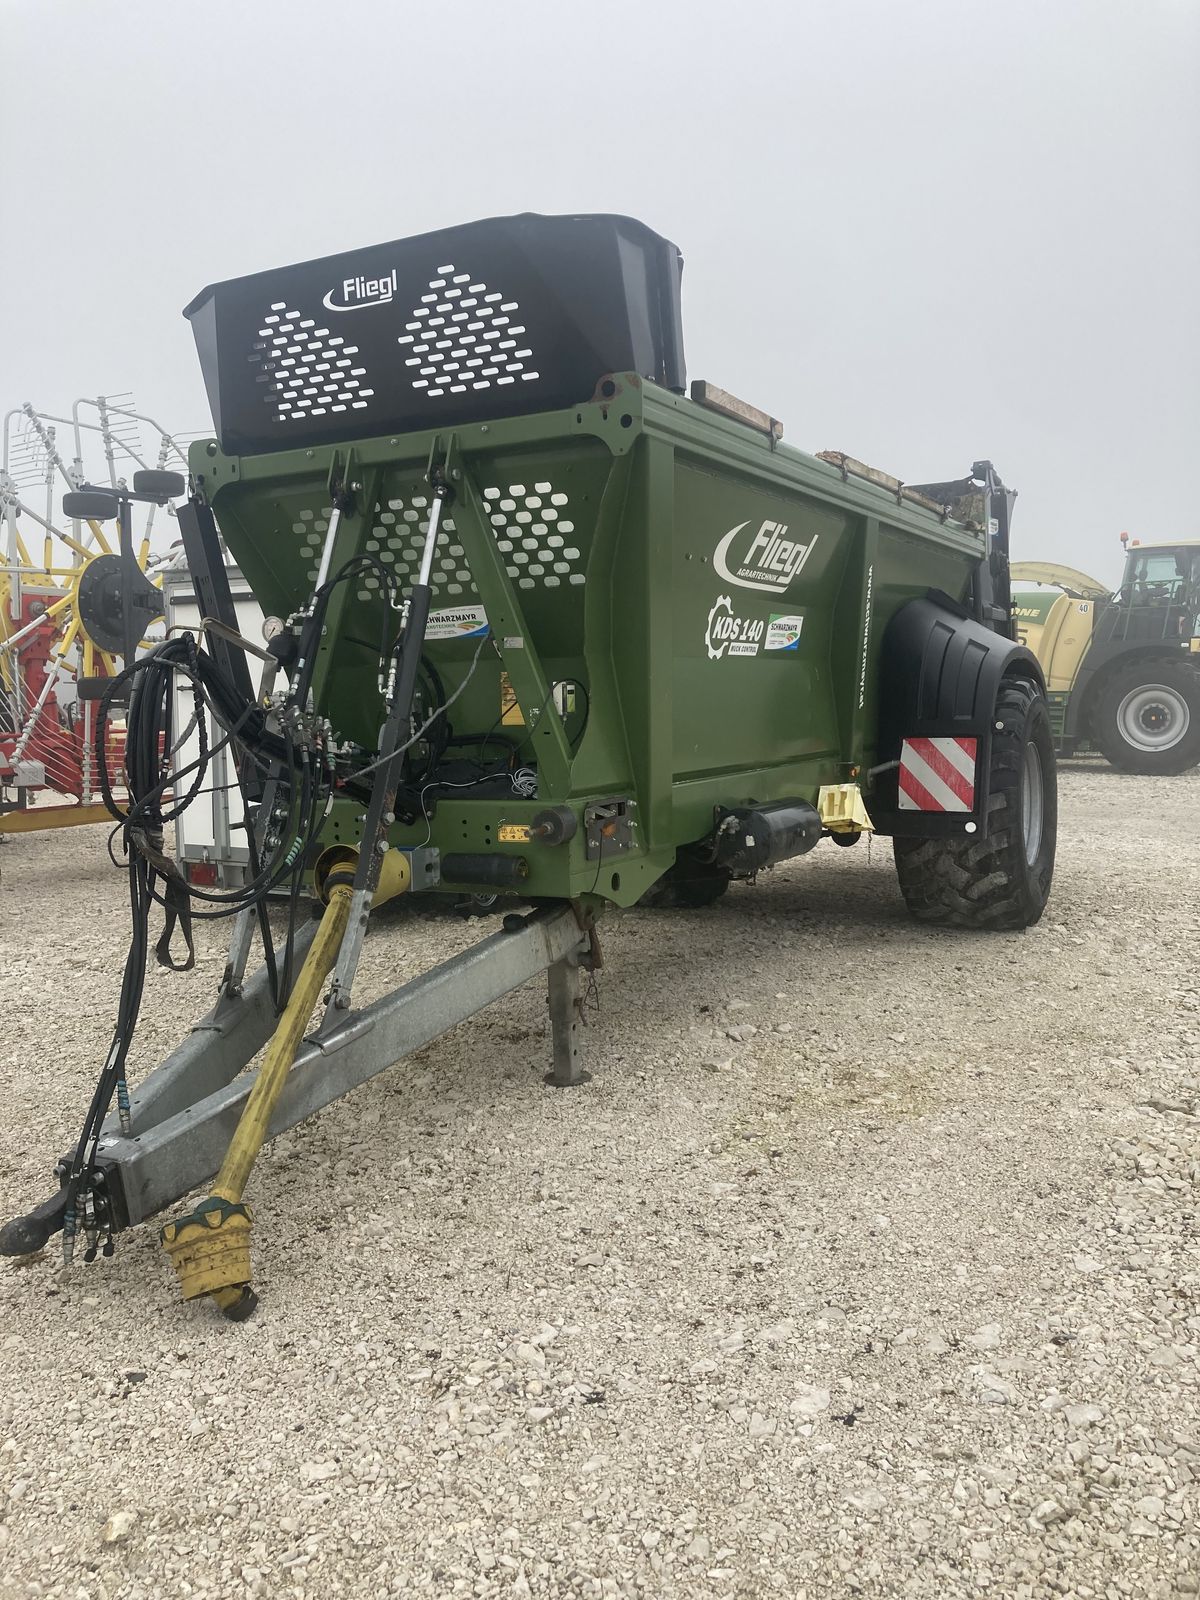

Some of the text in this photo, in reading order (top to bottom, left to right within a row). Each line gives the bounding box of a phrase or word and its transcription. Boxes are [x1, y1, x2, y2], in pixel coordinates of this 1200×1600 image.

[343, 269, 397, 301] Fliegl
[743, 520, 819, 584] Fliegl
[736, 567, 779, 582] AGRARTECHNIK
[1079, 604, 1088, 612] 40
[712, 616, 764, 642] KDS 140
[859, 565, 873, 709] www.schwarzmayr.at
